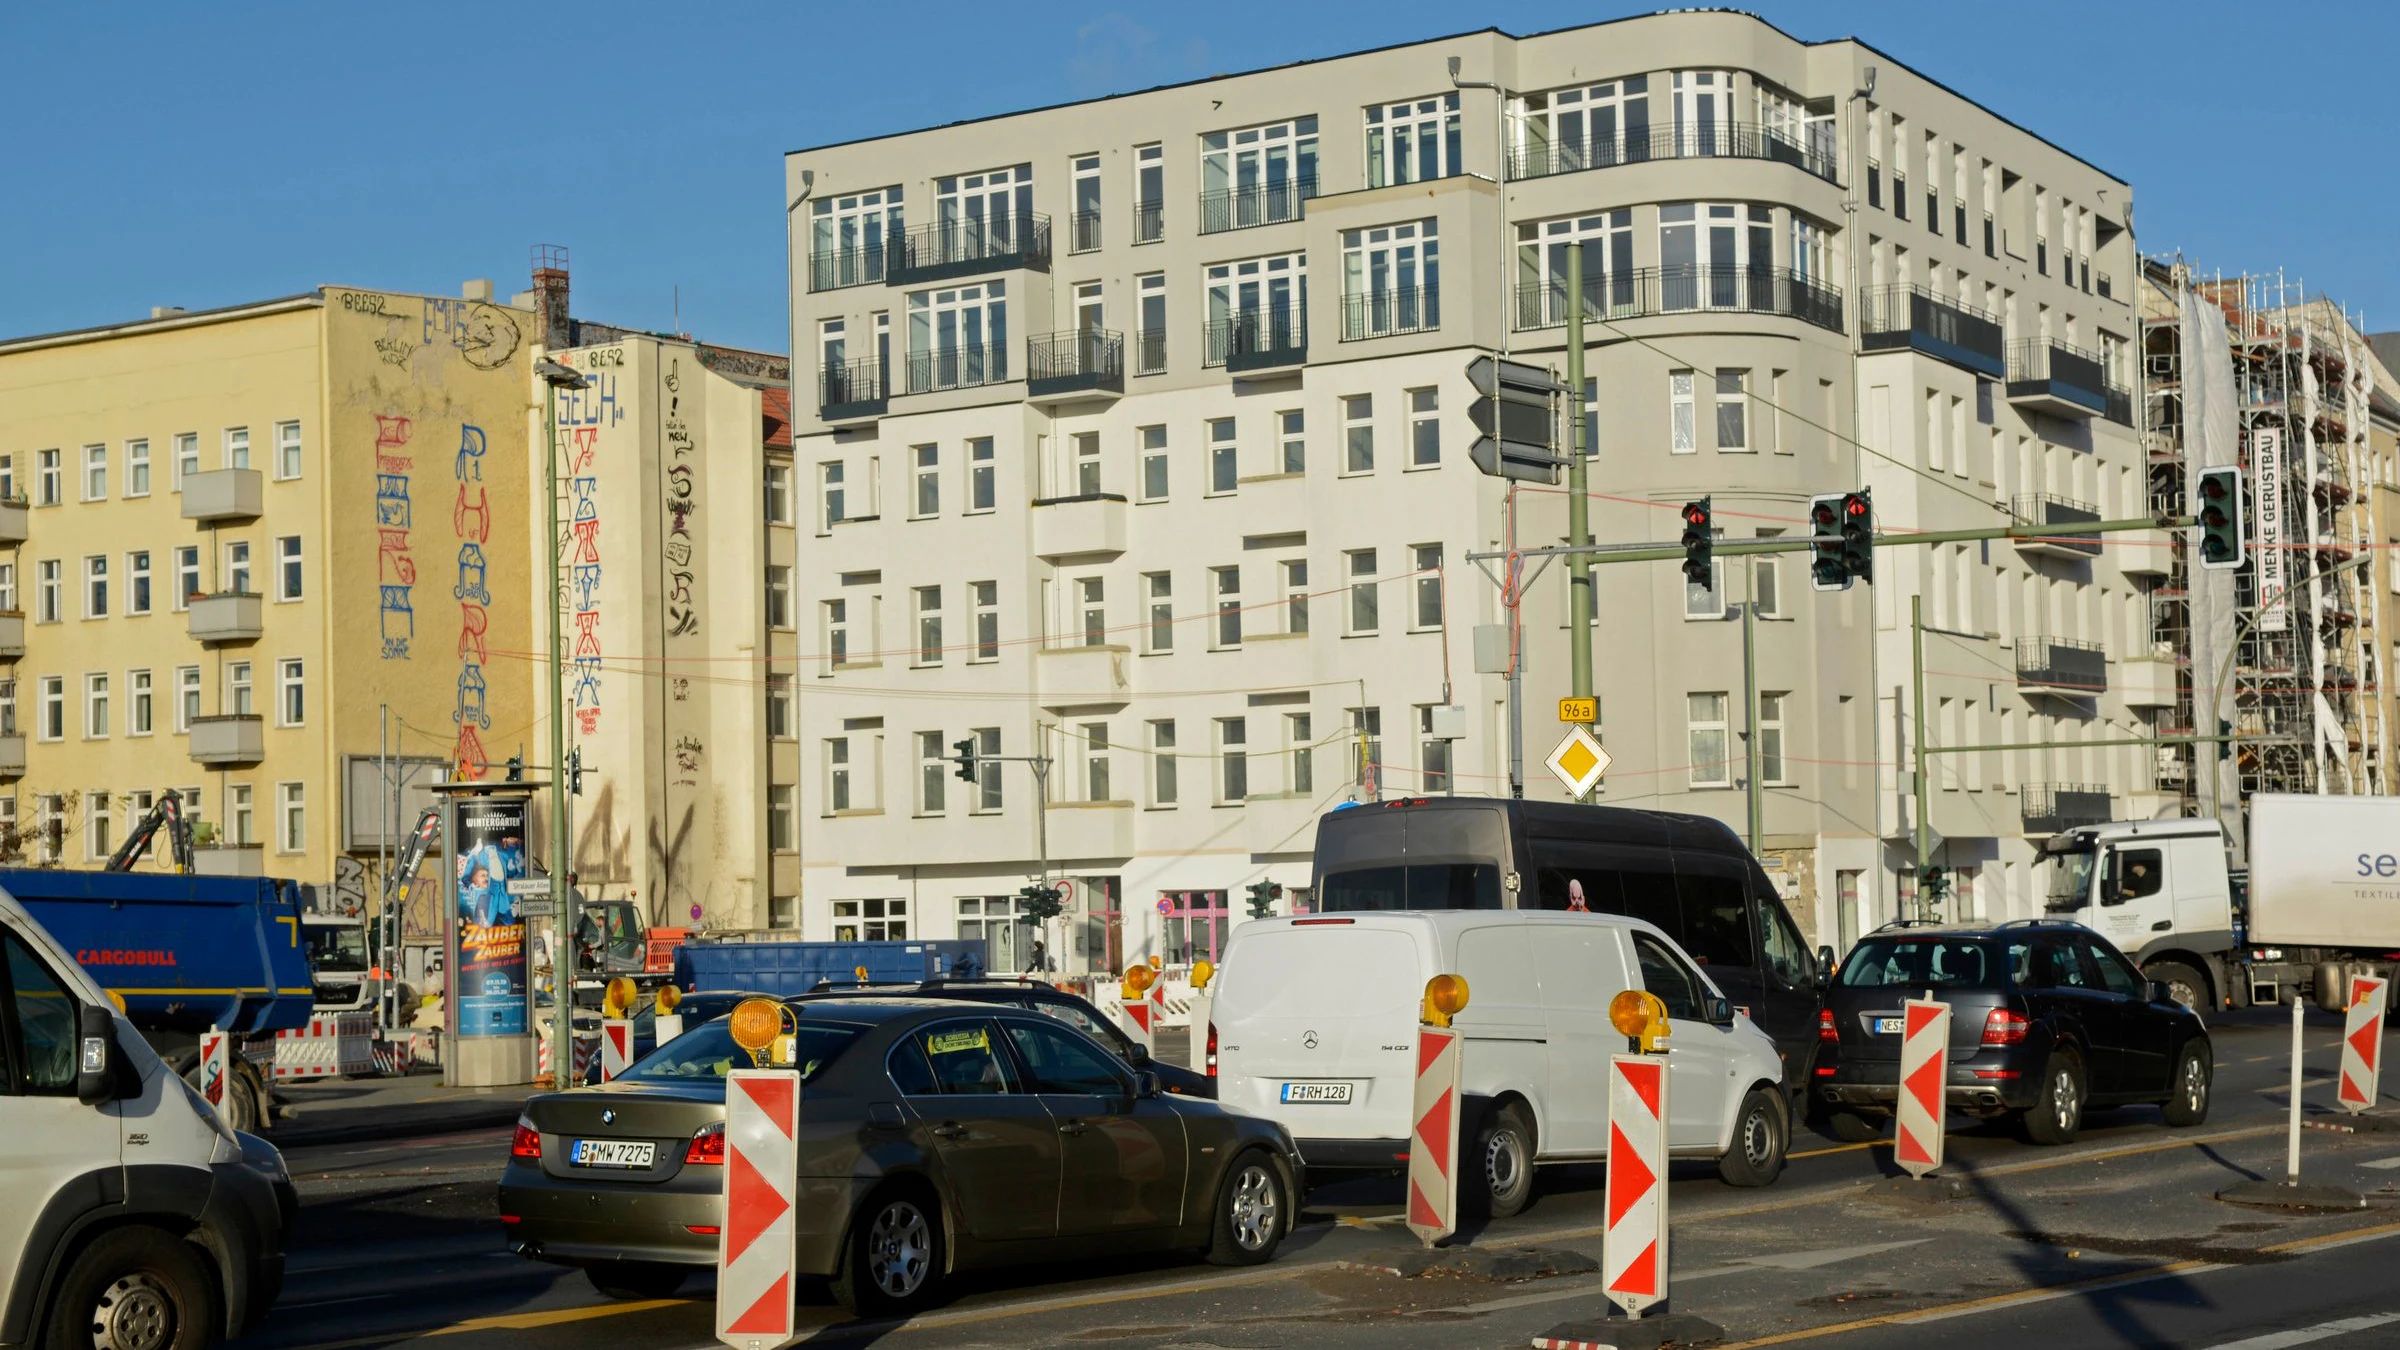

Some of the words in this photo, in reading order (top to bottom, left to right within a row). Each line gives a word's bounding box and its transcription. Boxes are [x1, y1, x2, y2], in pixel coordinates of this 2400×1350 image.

[2259, 435, 2276, 522] GERÜSTBAU
[2264, 526, 2277, 579] MENKE
[1564, 704, 1579, 718] 96
[1582, 706, 1590, 717] a
[466, 817, 520, 828] WINTERGARTEN
[513, 882, 536, 890] Stralauer
[537, 881, 549, 889] Allee
[462, 923, 526, 951] ZAUBER
[76, 949, 176, 966] CARGOBULL
[474, 942, 520, 961] ZAUBER
[1881, 1020, 1899, 1032] NES
[1291, 1086, 1300, 1100] F
[1306, 1086, 1323, 1100] RH
[1325, 1086, 1346, 1100] 128
[580, 1143, 589, 1160] B
[596, 1145, 616, 1161] MW
[617, 1145, 652, 1163] 7275
